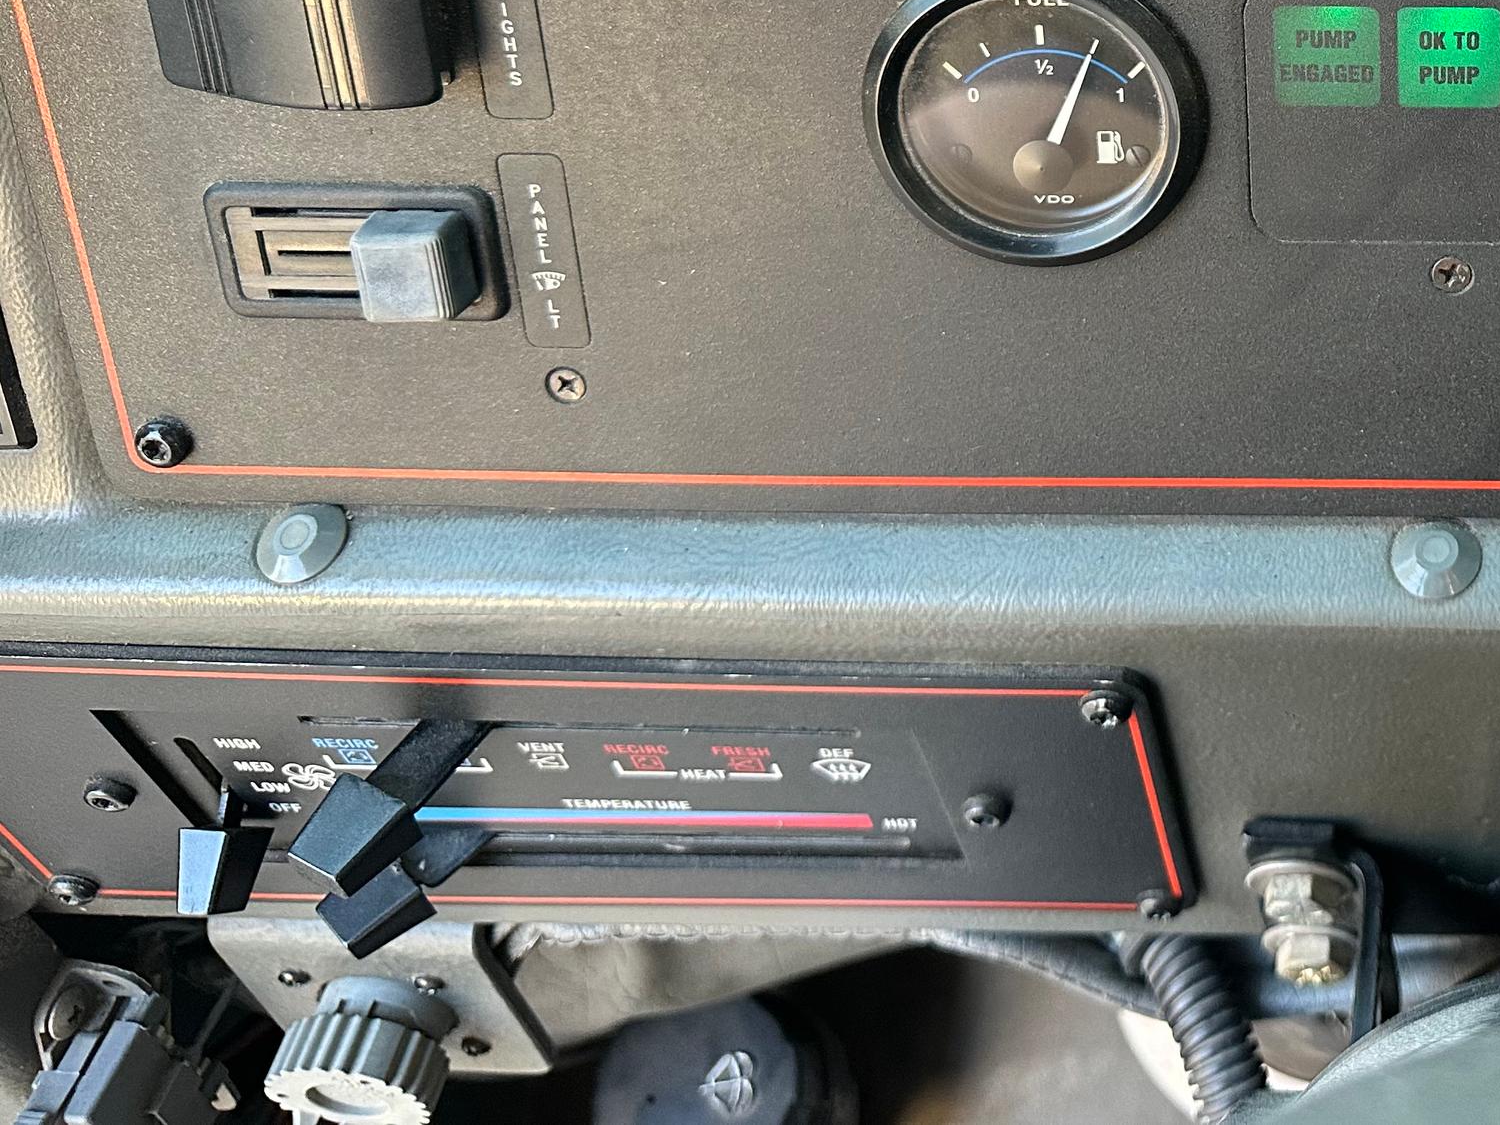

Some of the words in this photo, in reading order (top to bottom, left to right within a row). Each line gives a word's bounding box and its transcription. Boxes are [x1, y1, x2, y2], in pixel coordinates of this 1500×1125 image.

[1295, 29, 1357, 49] PUMP
[1419, 31, 1447, 50] OK
[1453, 31, 1480, 51] TO
[1279, 64, 1375, 84] ENGAGED
[1418, 66, 1480, 85] PUMP
[967, 87, 980, 103] 0
[1115, 87, 1125, 103] 1
[1033, 194, 1075, 205] VDO
[528, 183, 552, 264] PANEL
[547, 299, 561, 329] LT
[213, 737, 262, 750] HIGH
[312, 737, 379, 750] RECIRC
[517, 741, 565, 753] VENT
[603, 743, 670, 756] RECIRC
[710, 744, 771, 758] FRESH
[818, 747, 855, 759] DEF
[233, 760, 275, 773] MED
[679, 768, 727, 781] HEAT
[251, 781, 291, 794] LOW
[268, 802, 302, 814] OFF
[562, 798, 692, 811] TEMPERATURE
[882, 817, 918, 830] HOT
